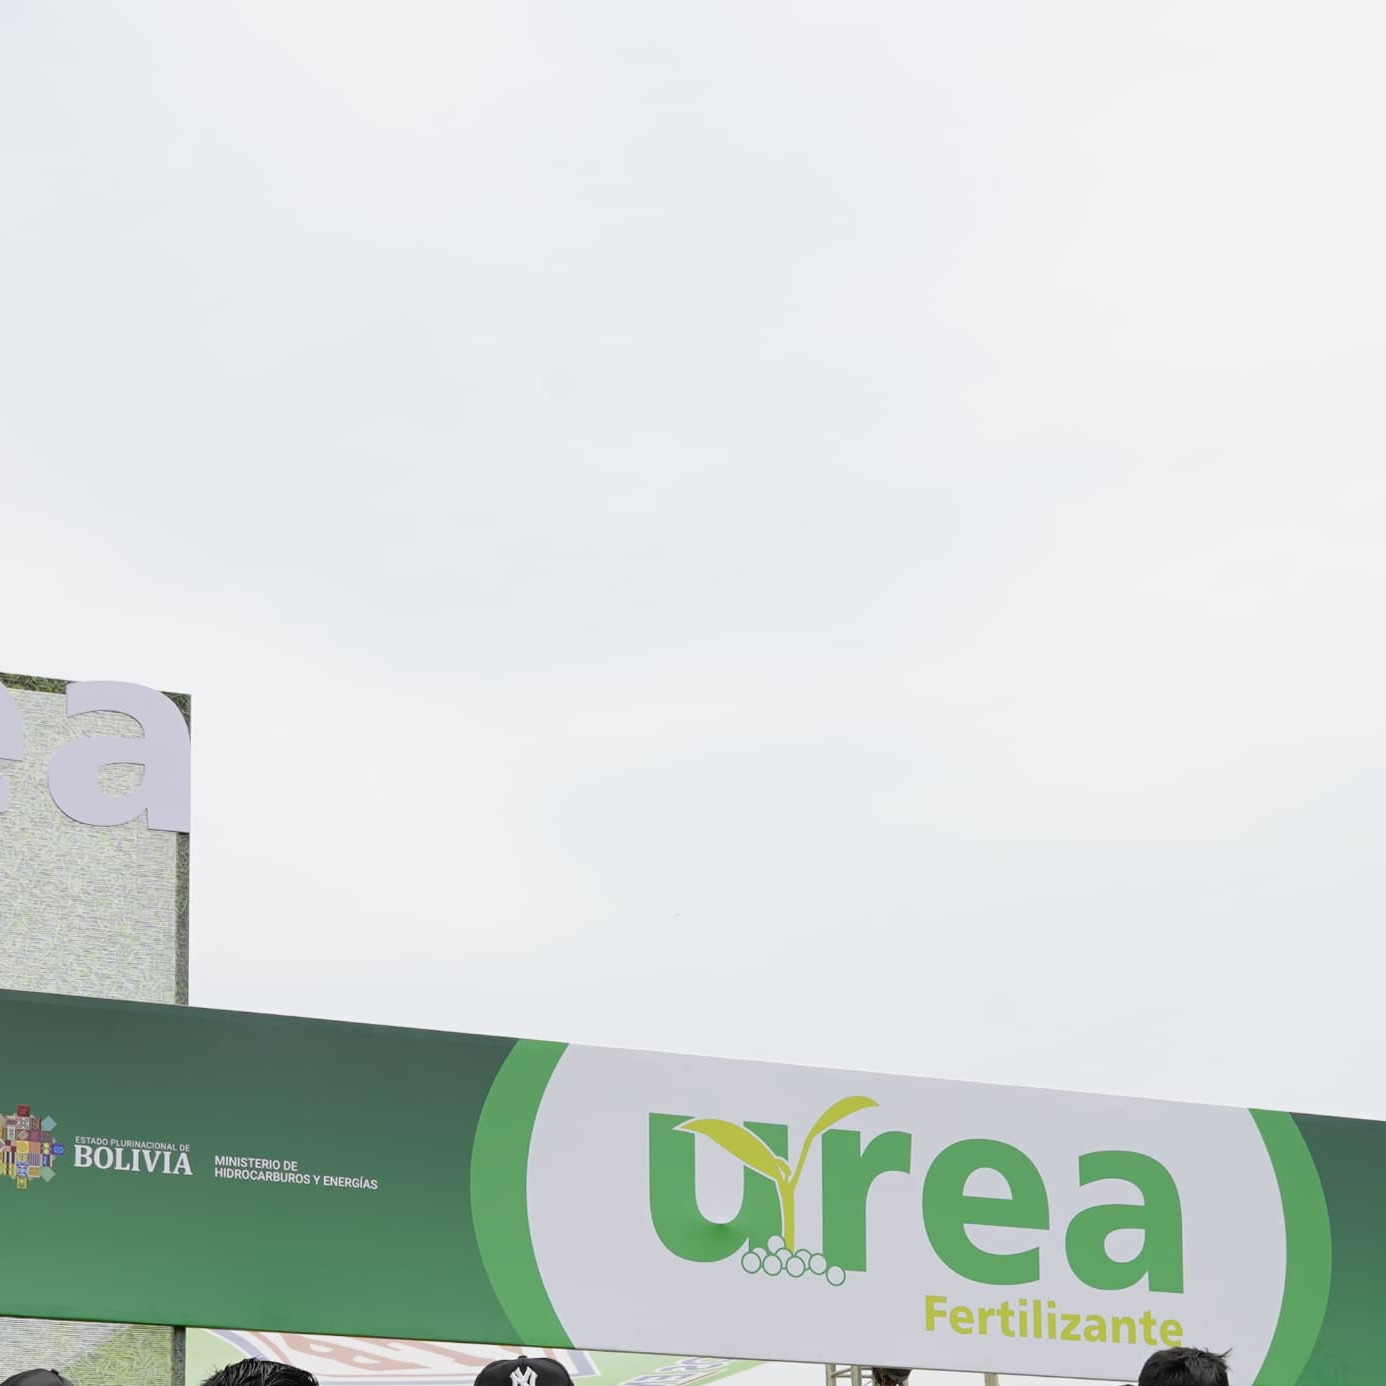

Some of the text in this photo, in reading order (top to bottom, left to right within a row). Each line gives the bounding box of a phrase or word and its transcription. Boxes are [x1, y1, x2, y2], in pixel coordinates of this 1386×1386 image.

[75, 1136, 190, 1152] ESTADO PLURINACIONAL DE
[73, 1144, 193, 1175] BOLIVIA
[214, 1155, 298, 1172] MINISTERIO DE
[214, 1167, 378, 1190] HIDROCARBUROS Y ENERGÍAS
[649, 1103, 1185, 1294] urea
[923, 1294, 1185, 1348] Fertilizante
